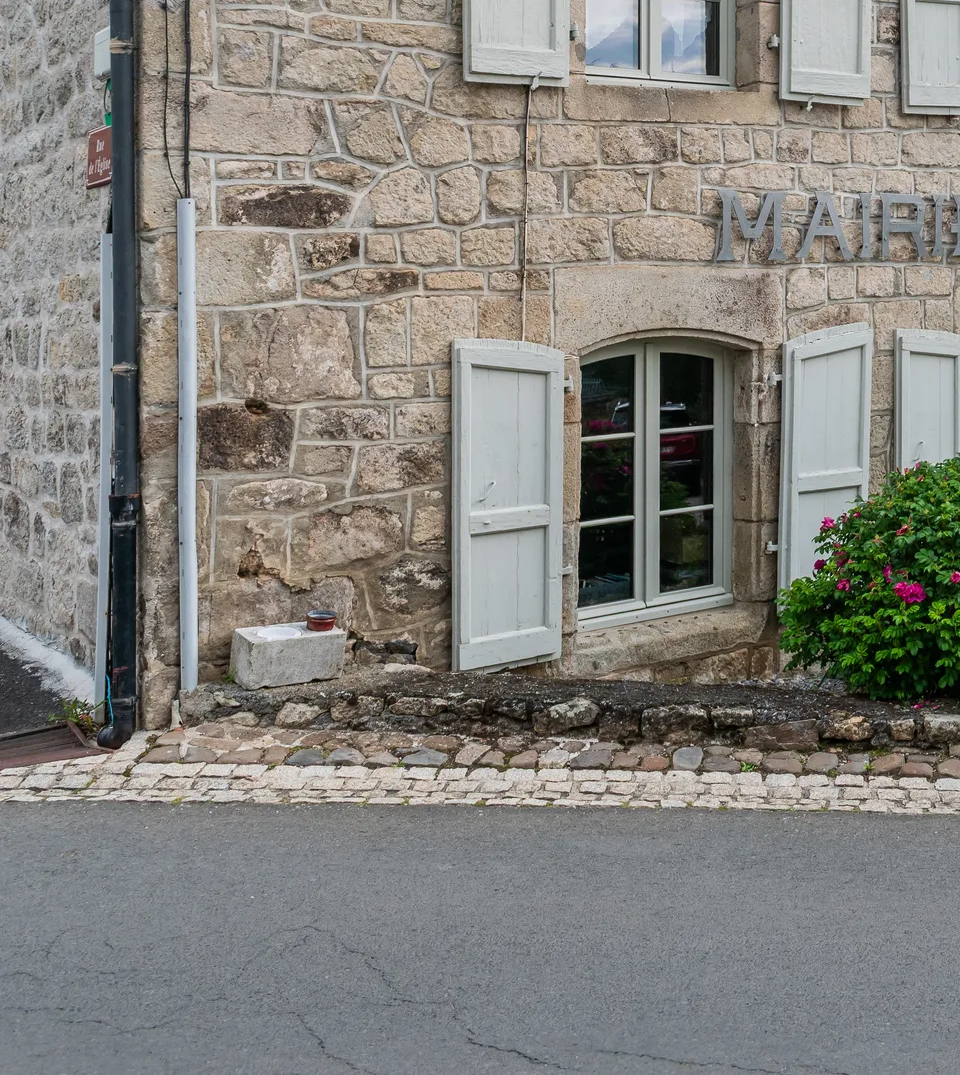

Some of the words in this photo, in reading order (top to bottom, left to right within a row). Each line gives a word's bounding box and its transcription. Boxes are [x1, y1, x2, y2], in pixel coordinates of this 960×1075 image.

[95, 139, 105, 153] Rue
[88, 161, 94, 175] de
[94, 156, 111, 176] l'Église
